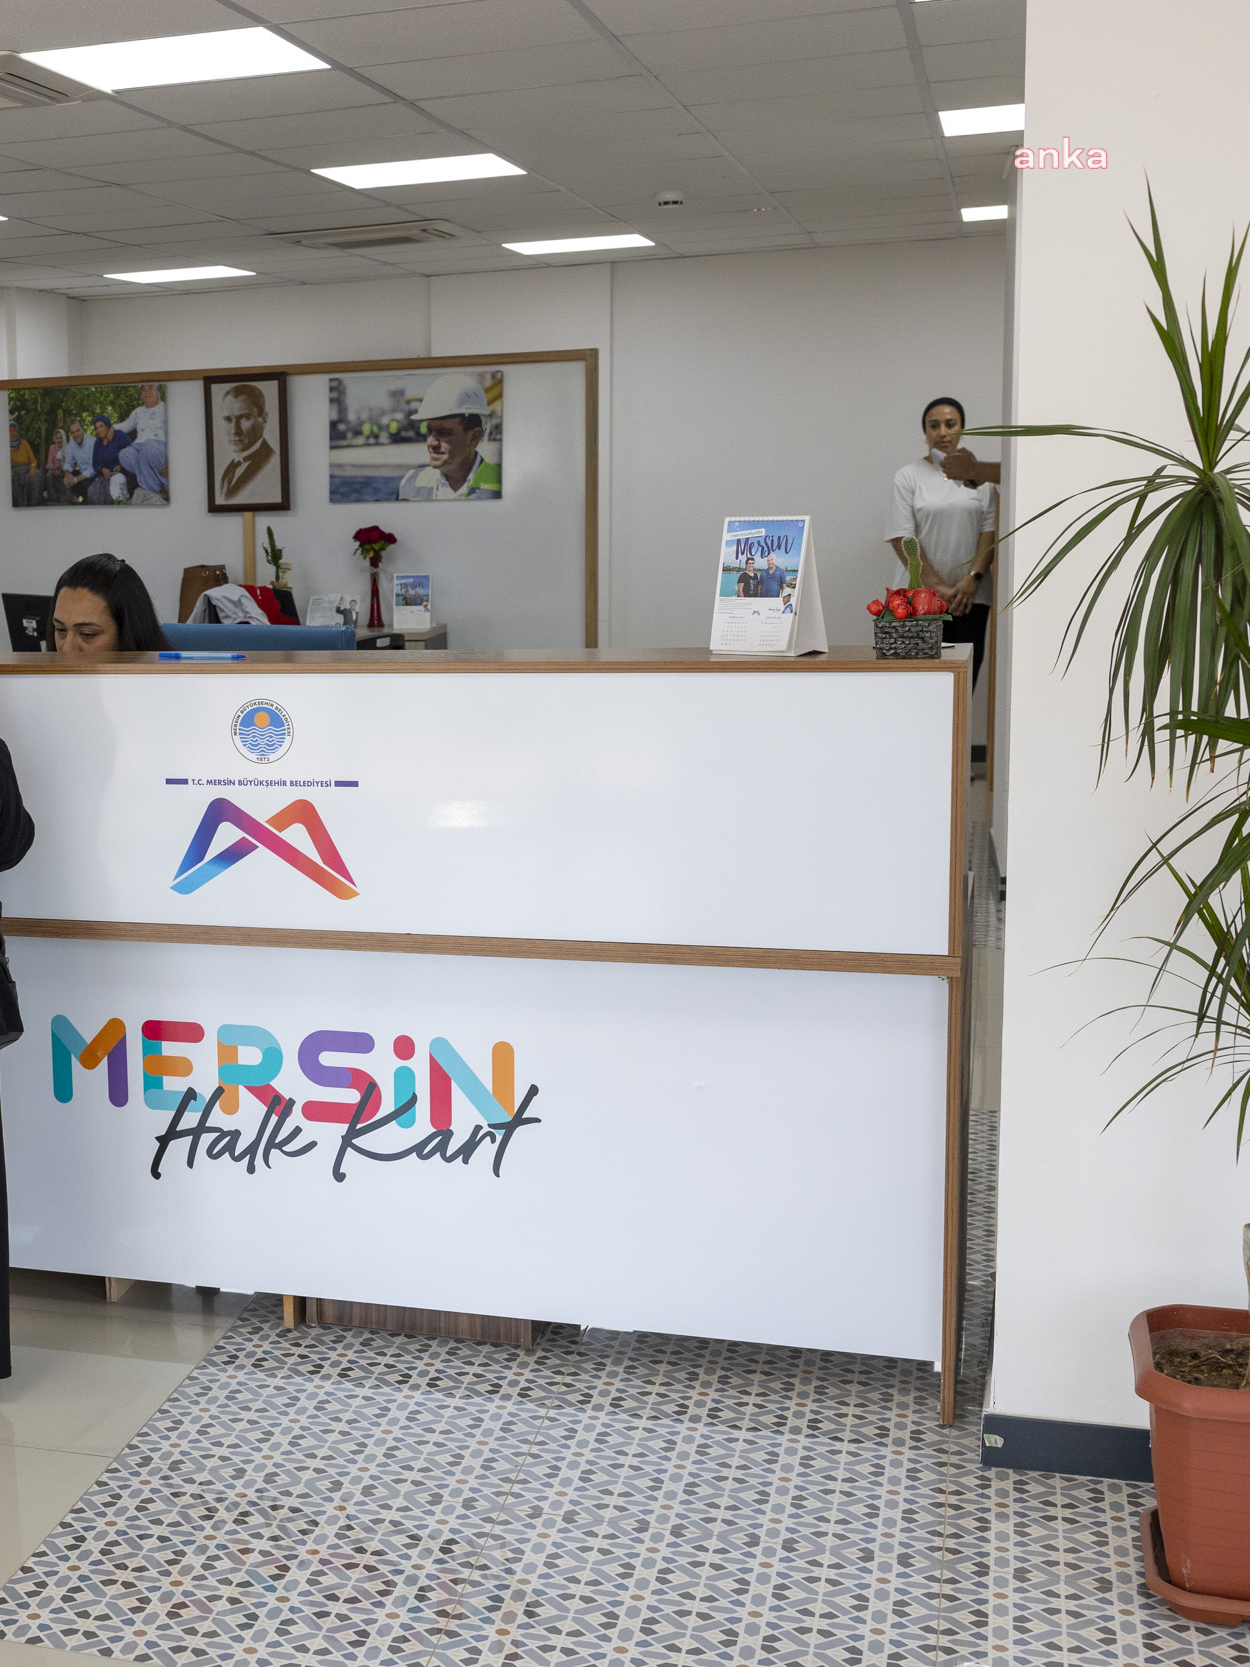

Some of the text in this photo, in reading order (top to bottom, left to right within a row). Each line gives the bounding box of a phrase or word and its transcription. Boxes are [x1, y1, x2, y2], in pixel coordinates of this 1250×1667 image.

[735, 535, 795, 560] Mersin
[191, 777, 332, 789] T.C. MERSİN BÜYÜKŞEHİR BELEDİYESİ
[150, 1081, 542, 1183] Halk Kart
